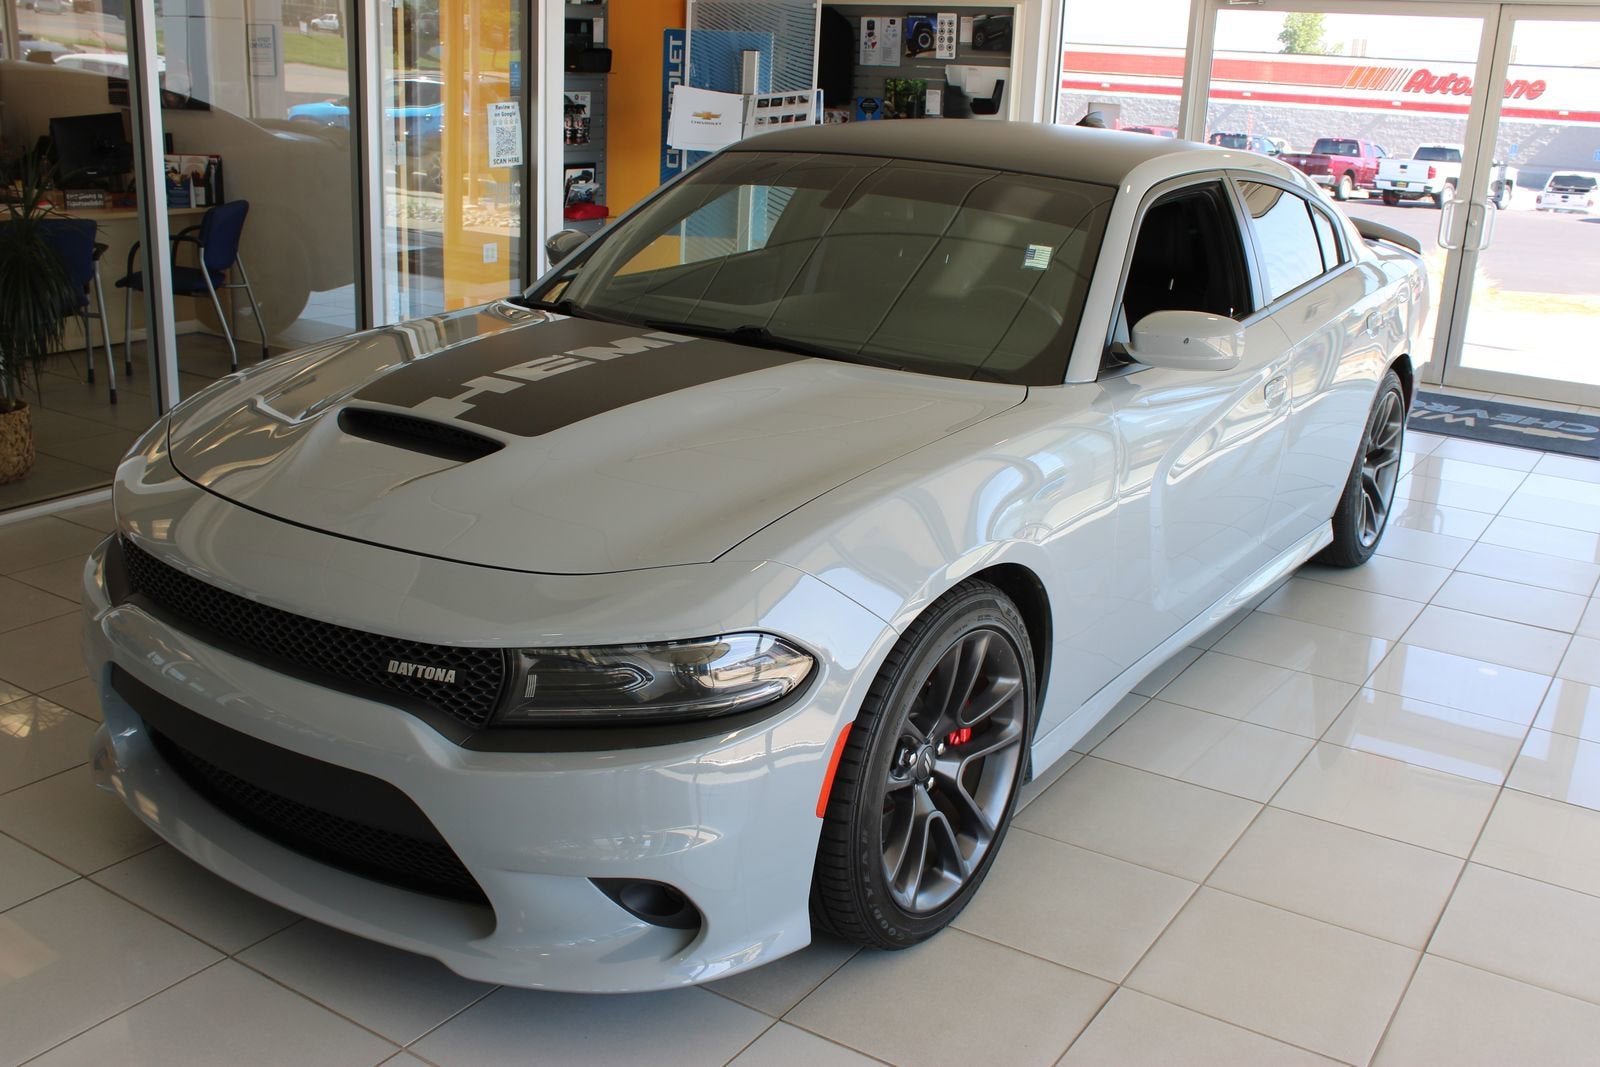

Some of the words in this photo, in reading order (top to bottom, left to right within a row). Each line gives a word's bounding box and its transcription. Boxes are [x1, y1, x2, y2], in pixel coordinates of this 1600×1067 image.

[666, 35, 683, 169] COLET
[1402, 68, 1547, 100] Autone
[410, 331, 700, 418] HEMI
[387, 659, 456, 684] DAYTONA
